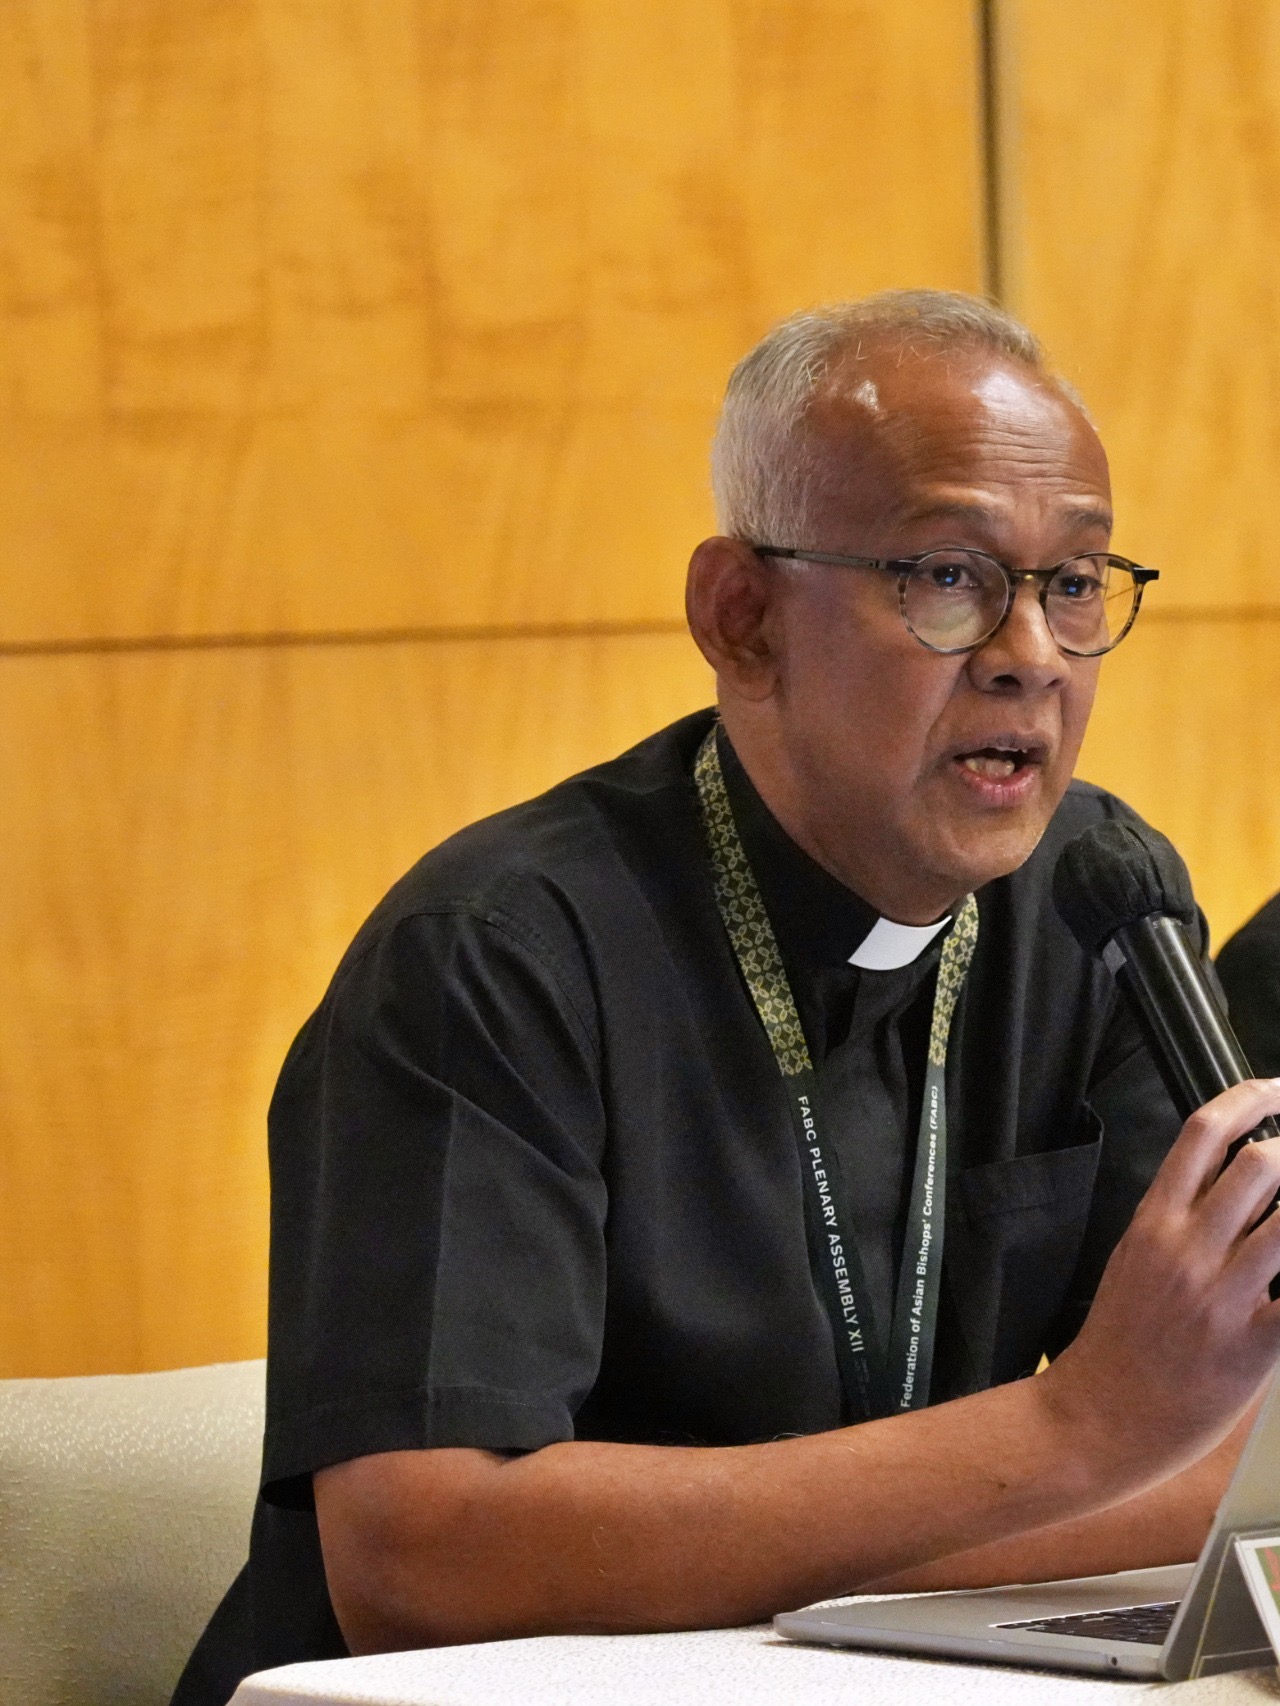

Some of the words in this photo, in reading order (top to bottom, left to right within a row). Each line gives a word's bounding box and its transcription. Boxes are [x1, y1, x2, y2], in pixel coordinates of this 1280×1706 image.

[929, 1085, 939, 1130] (FABC)
[923, 1133, 937, 1216] Conferences
[798, 1095, 817, 1142] FABC
[809, 1147, 838, 1227] PLENARY
[828, 1233, 860, 1325] ASSEMBLY
[848, 1328, 865, 1352] XII
[910, 1317, 921, 1333] of
[911, 1279, 926, 1316] Asian
[900, 1336, 919, 1408] Federation
